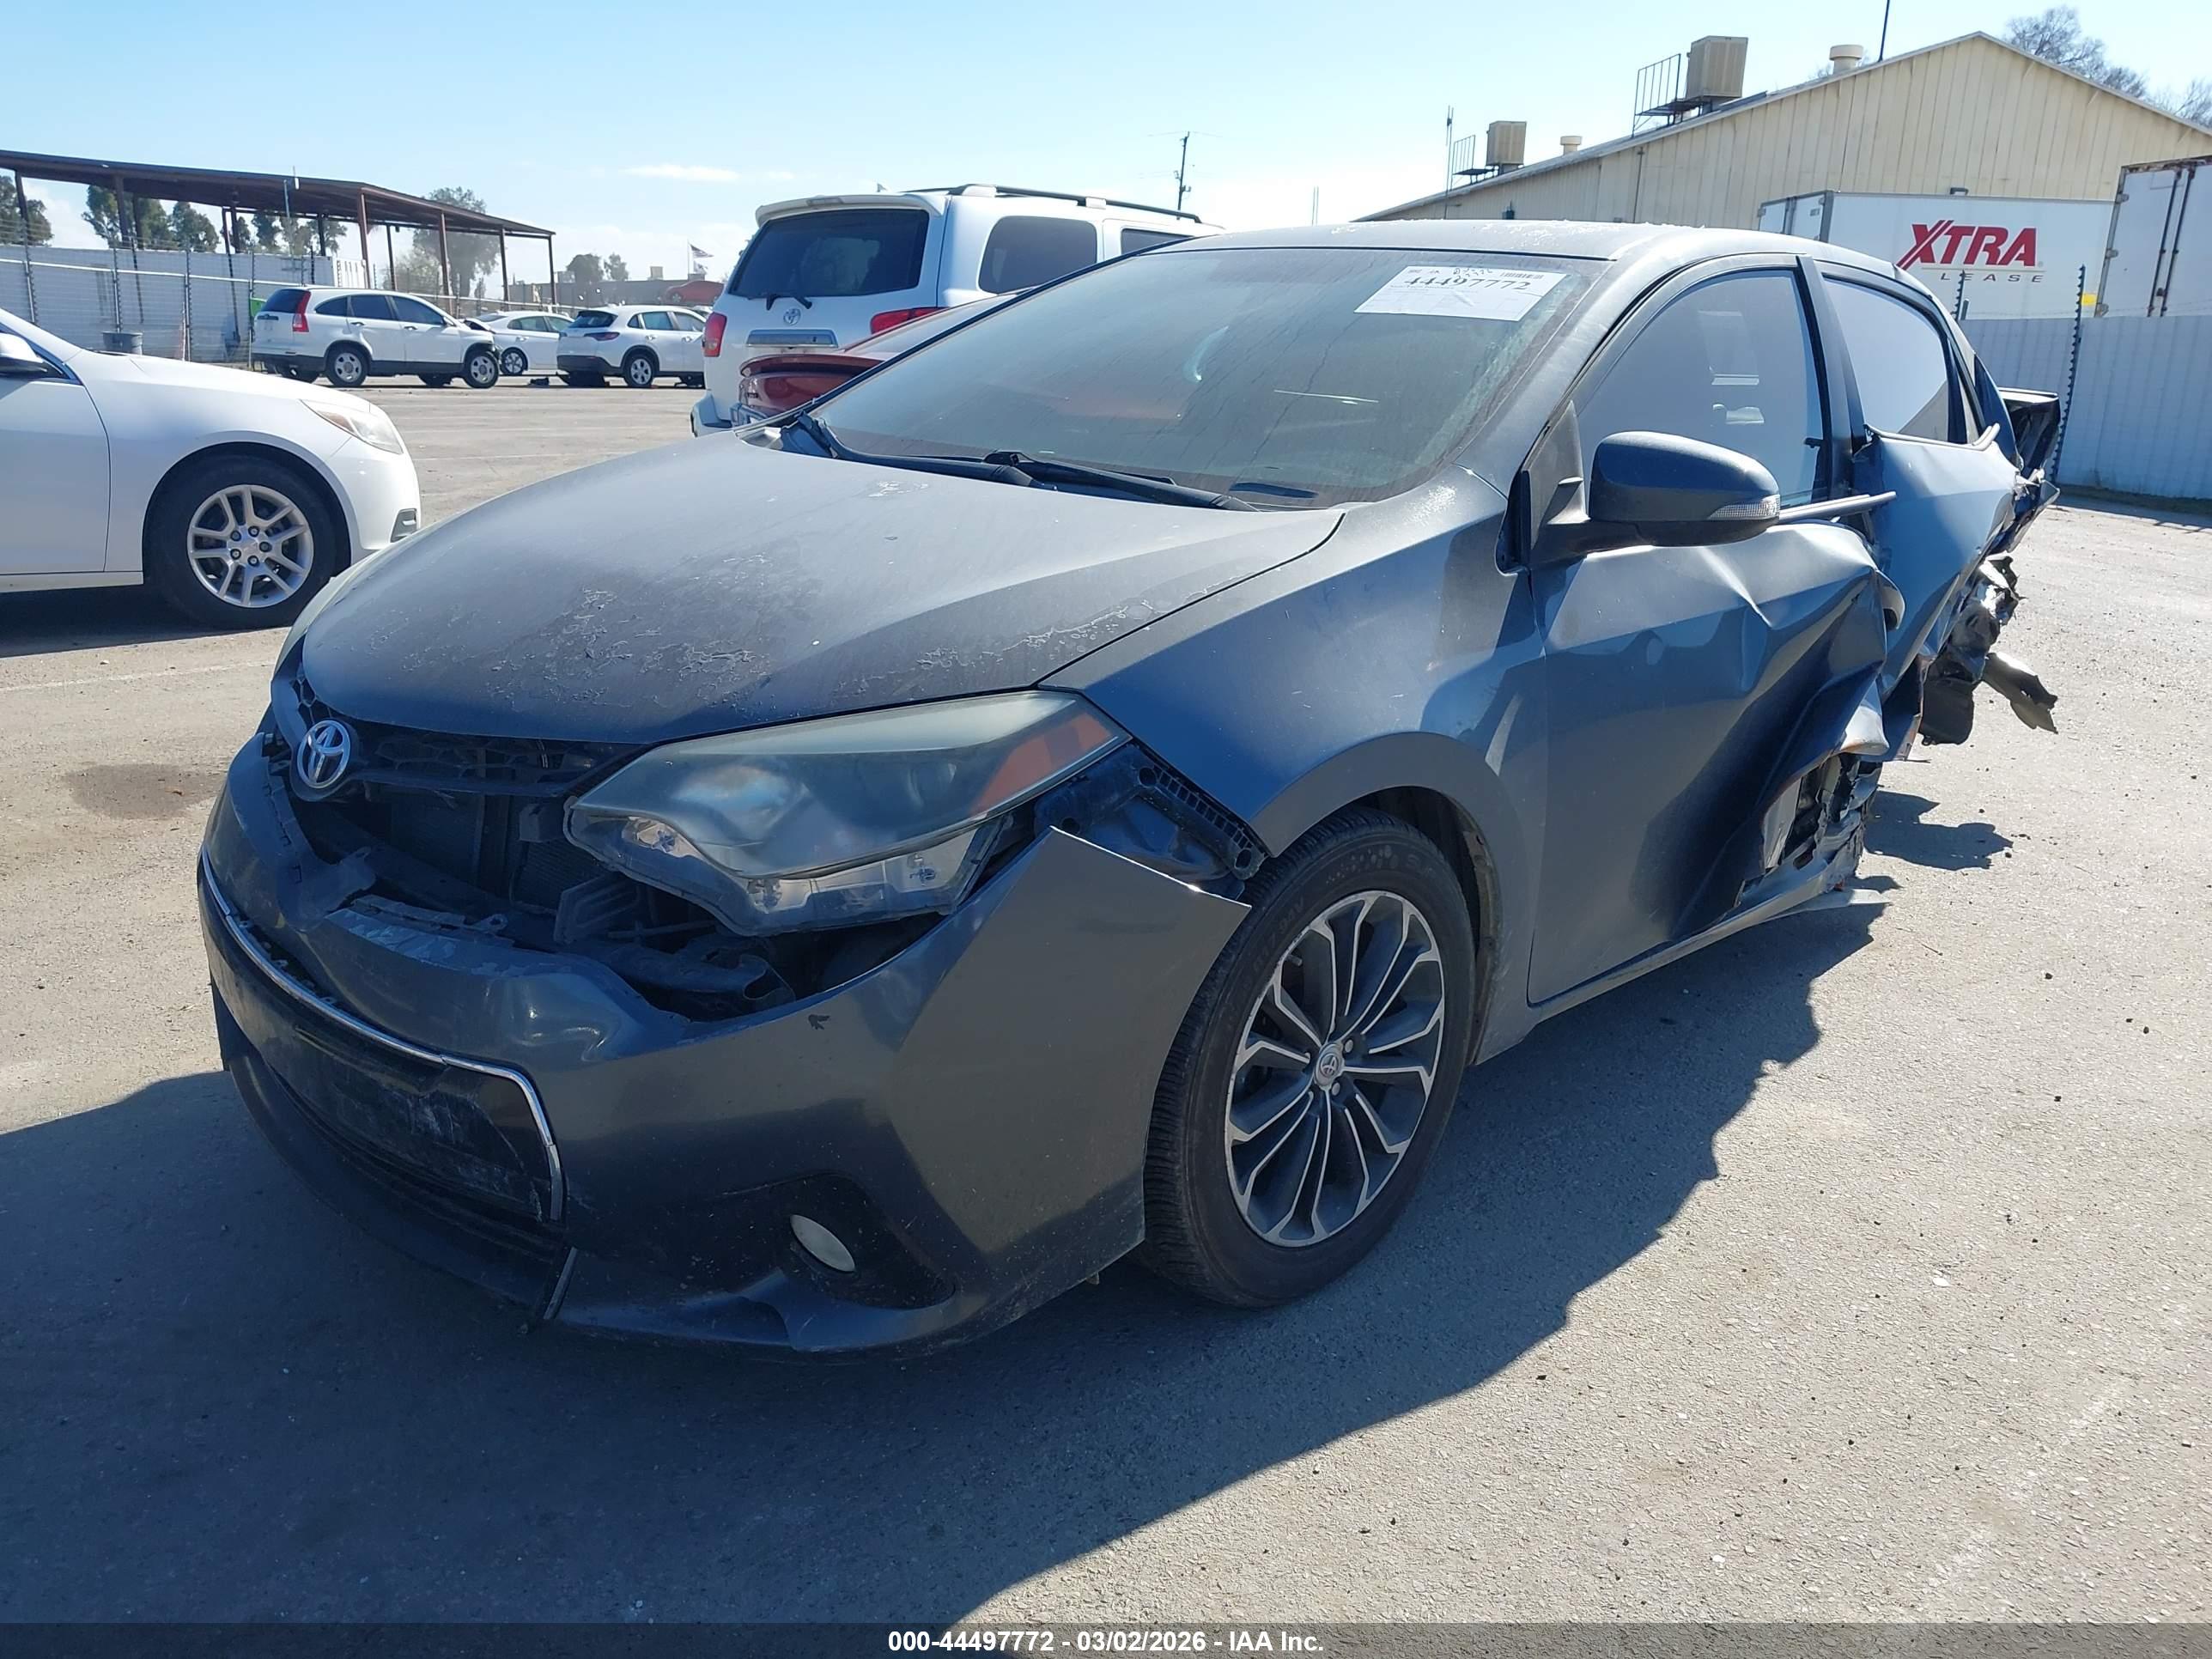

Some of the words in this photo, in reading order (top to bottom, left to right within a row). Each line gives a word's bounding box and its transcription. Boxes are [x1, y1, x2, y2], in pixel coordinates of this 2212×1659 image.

[1896, 220, 2037, 271] XTRA
[1404, 276, 1531, 290] 44497772
[1940, 272, 2044, 283] LEASE
